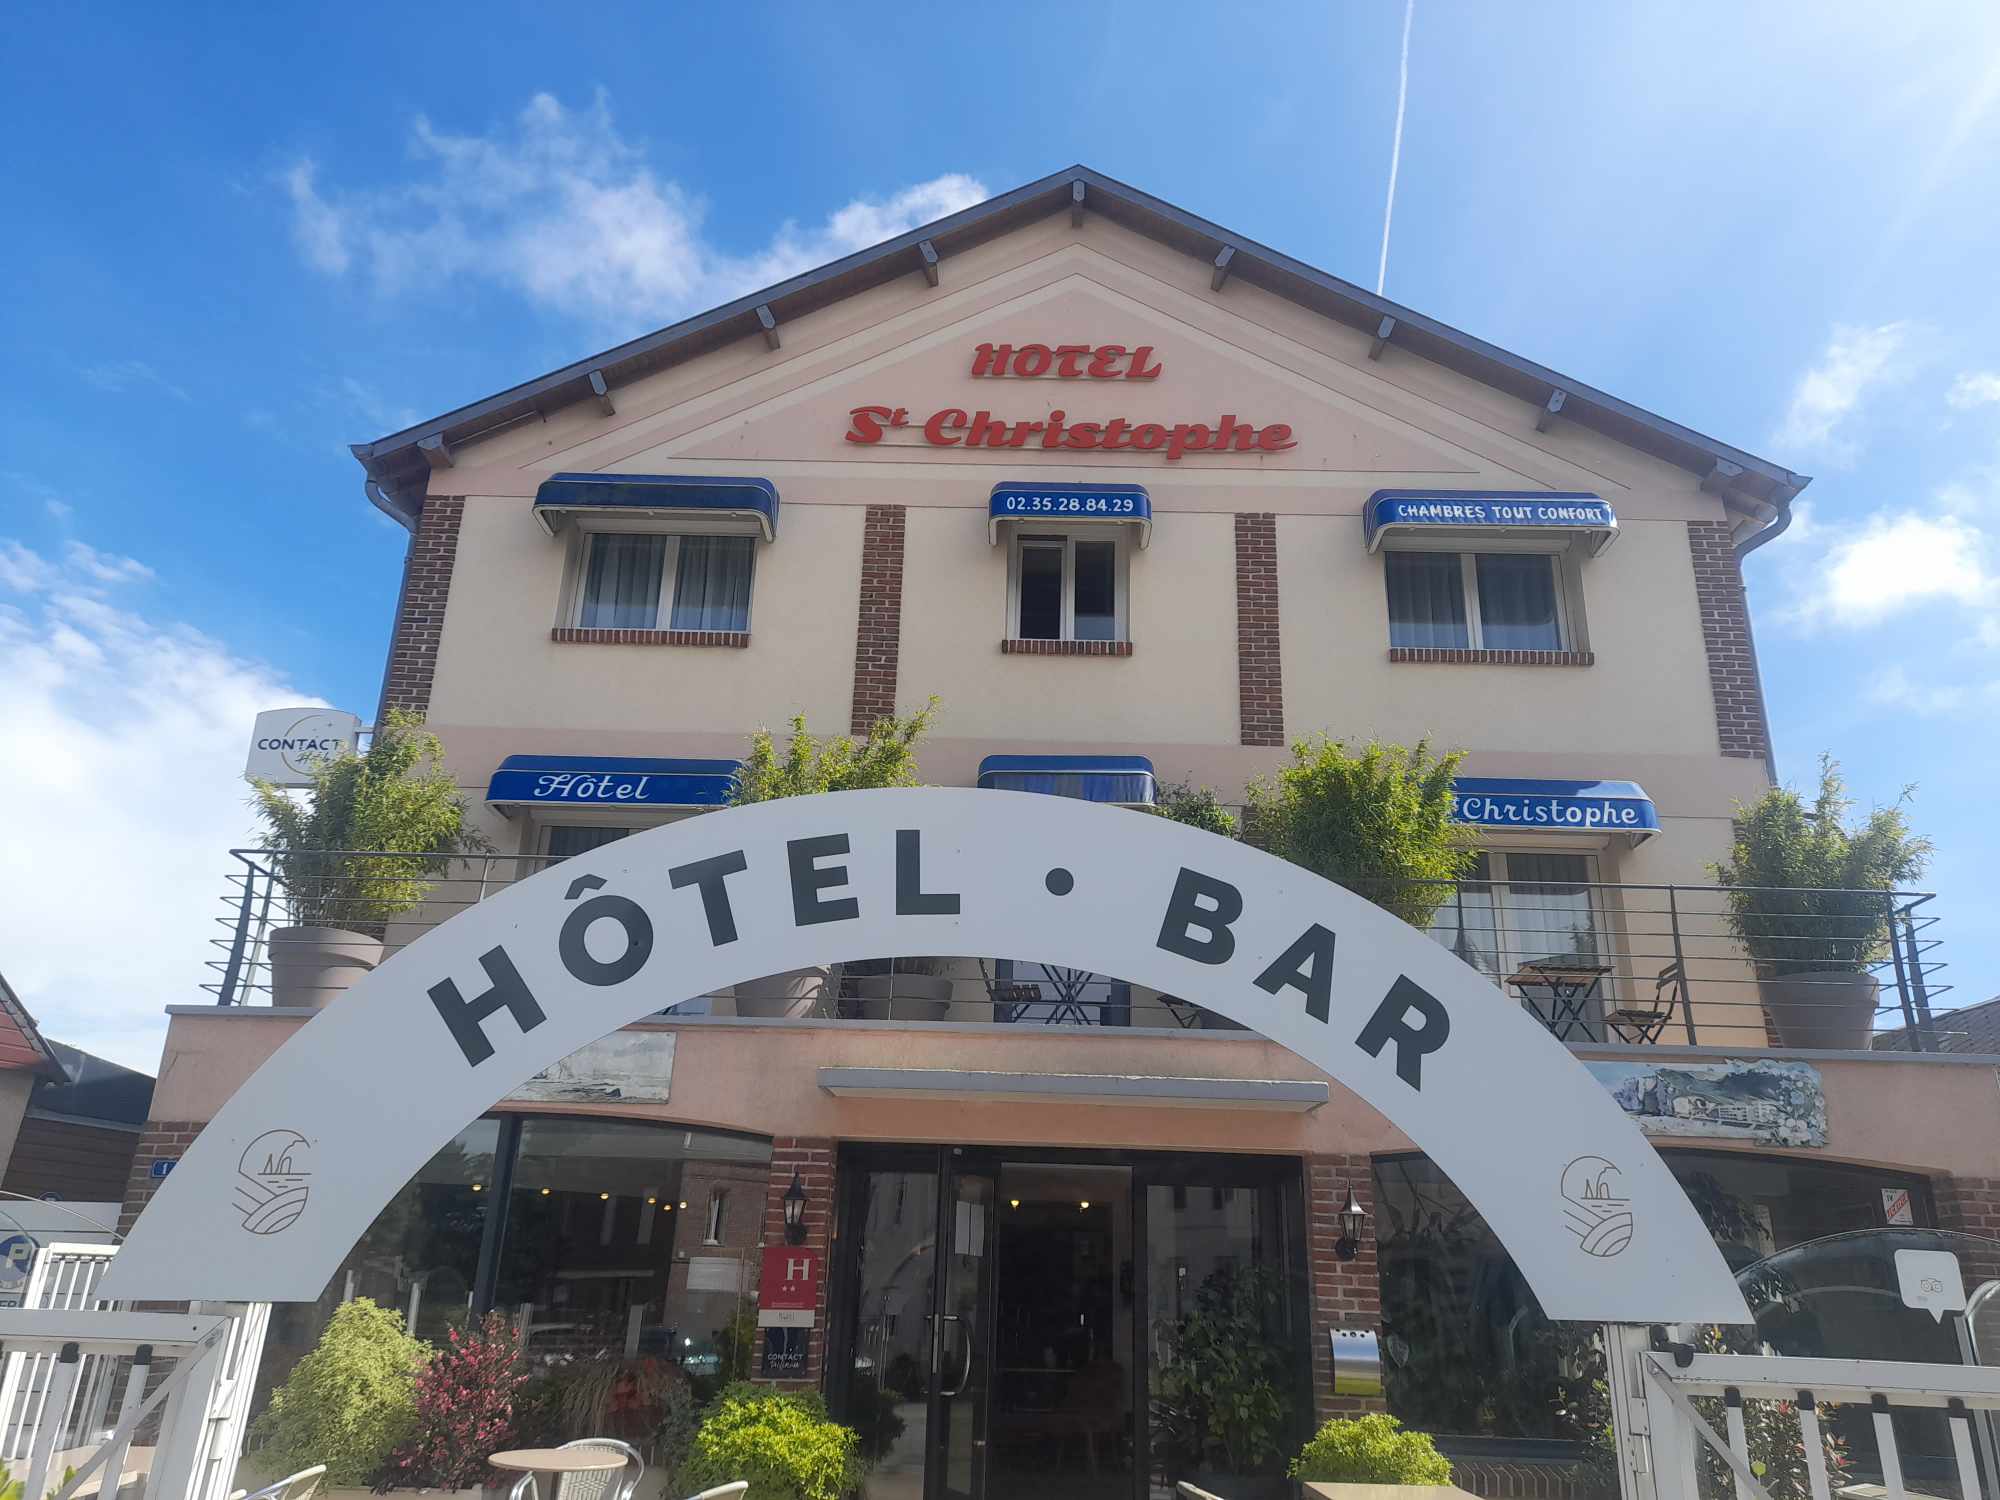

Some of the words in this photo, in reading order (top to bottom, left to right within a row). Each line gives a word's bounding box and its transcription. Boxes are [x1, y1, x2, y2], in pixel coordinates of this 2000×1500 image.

[971, 343, 1163, 378] HOTEL
[845, 406, 909, 443] St
[924, 408, 1298, 460] Christophe
[1006, 496, 1134, 512] 02.35.28.84.29
[1399, 504, 1486, 518] CHAMBRES
[1492, 506, 1532, 519] TOUT
[1538, 507, 1603, 520] CONFORT
[257, 738, 341, 751] CONTACT
[533, 773, 651, 799] Hôtel
[1462, 797, 1640, 826] Christophe
[426, 828, 962, 1068] HÔTEL
[1156, 865, 1451, 1093] BAR
[785, 1258, 812, 1281] H
[767, 1353, 804, 1361] CONTACT
